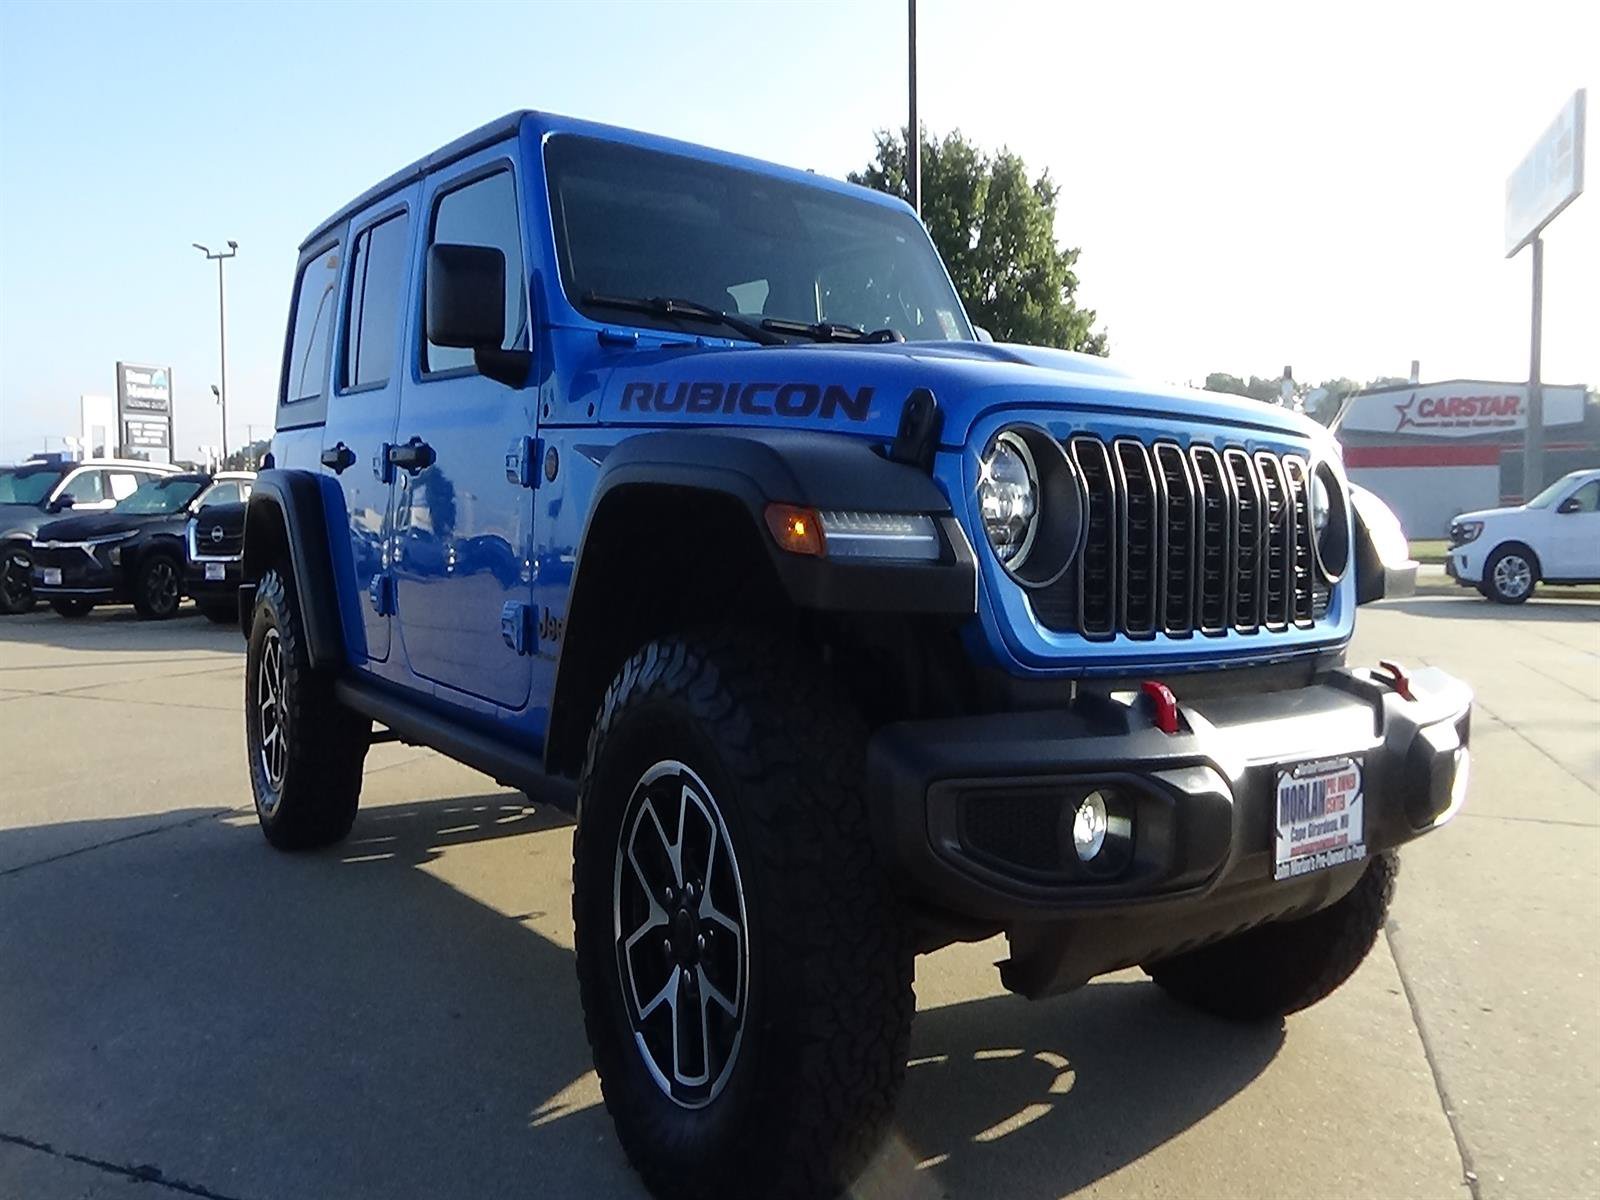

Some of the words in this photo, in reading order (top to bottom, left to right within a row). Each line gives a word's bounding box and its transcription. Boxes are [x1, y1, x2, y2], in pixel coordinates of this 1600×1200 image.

[620, 382, 876, 422] RUBICON
[1418, 396, 1520, 418] CARSTAR
[1280, 780, 1326, 826] MORLAN
[1290, 827, 1306, 842] Cape
